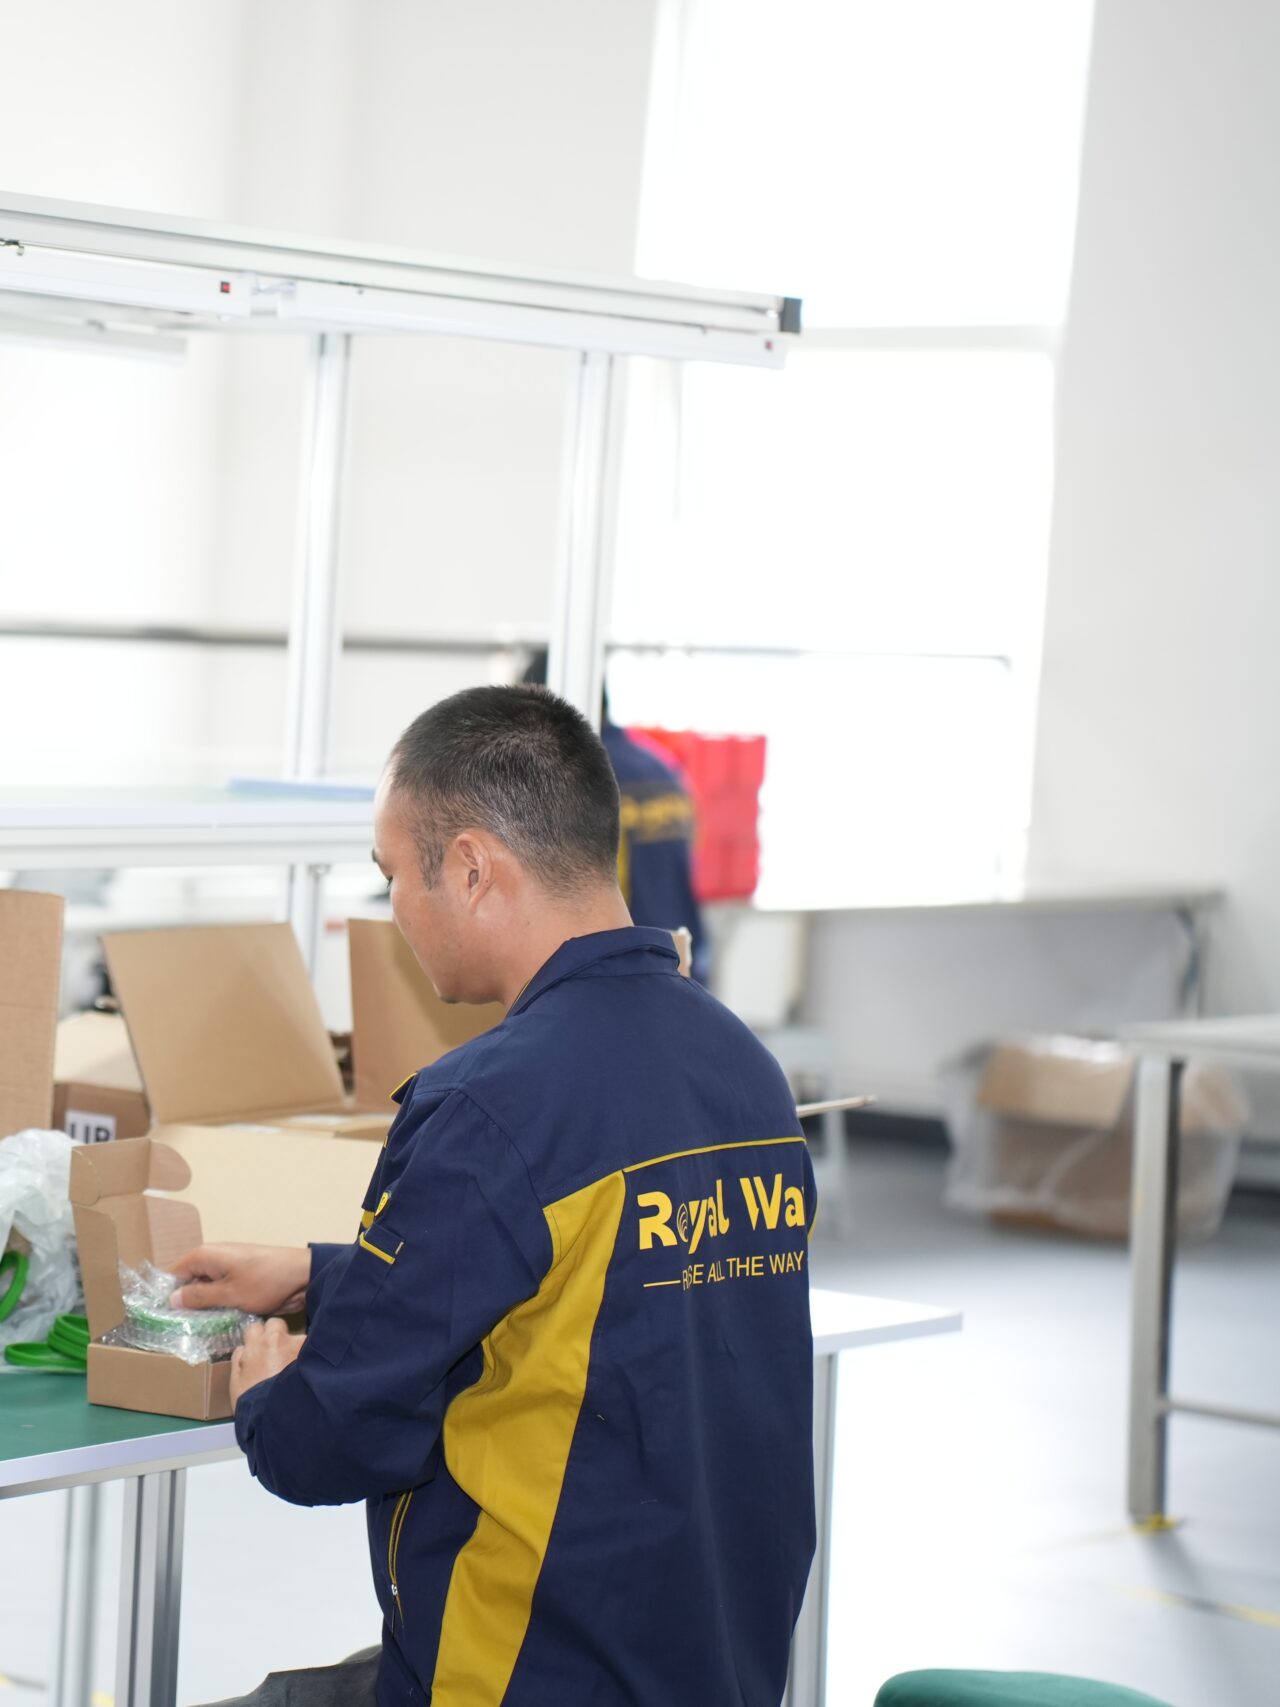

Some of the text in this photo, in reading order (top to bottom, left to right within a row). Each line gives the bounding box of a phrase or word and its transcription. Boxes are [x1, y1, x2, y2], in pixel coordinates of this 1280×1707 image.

[637, 1173, 806, 1255] Royal Wa
[707, 1260, 726, 1284] ALL
[726, 1256, 765, 1278] THE
[769, 1250, 805, 1275] WAY
